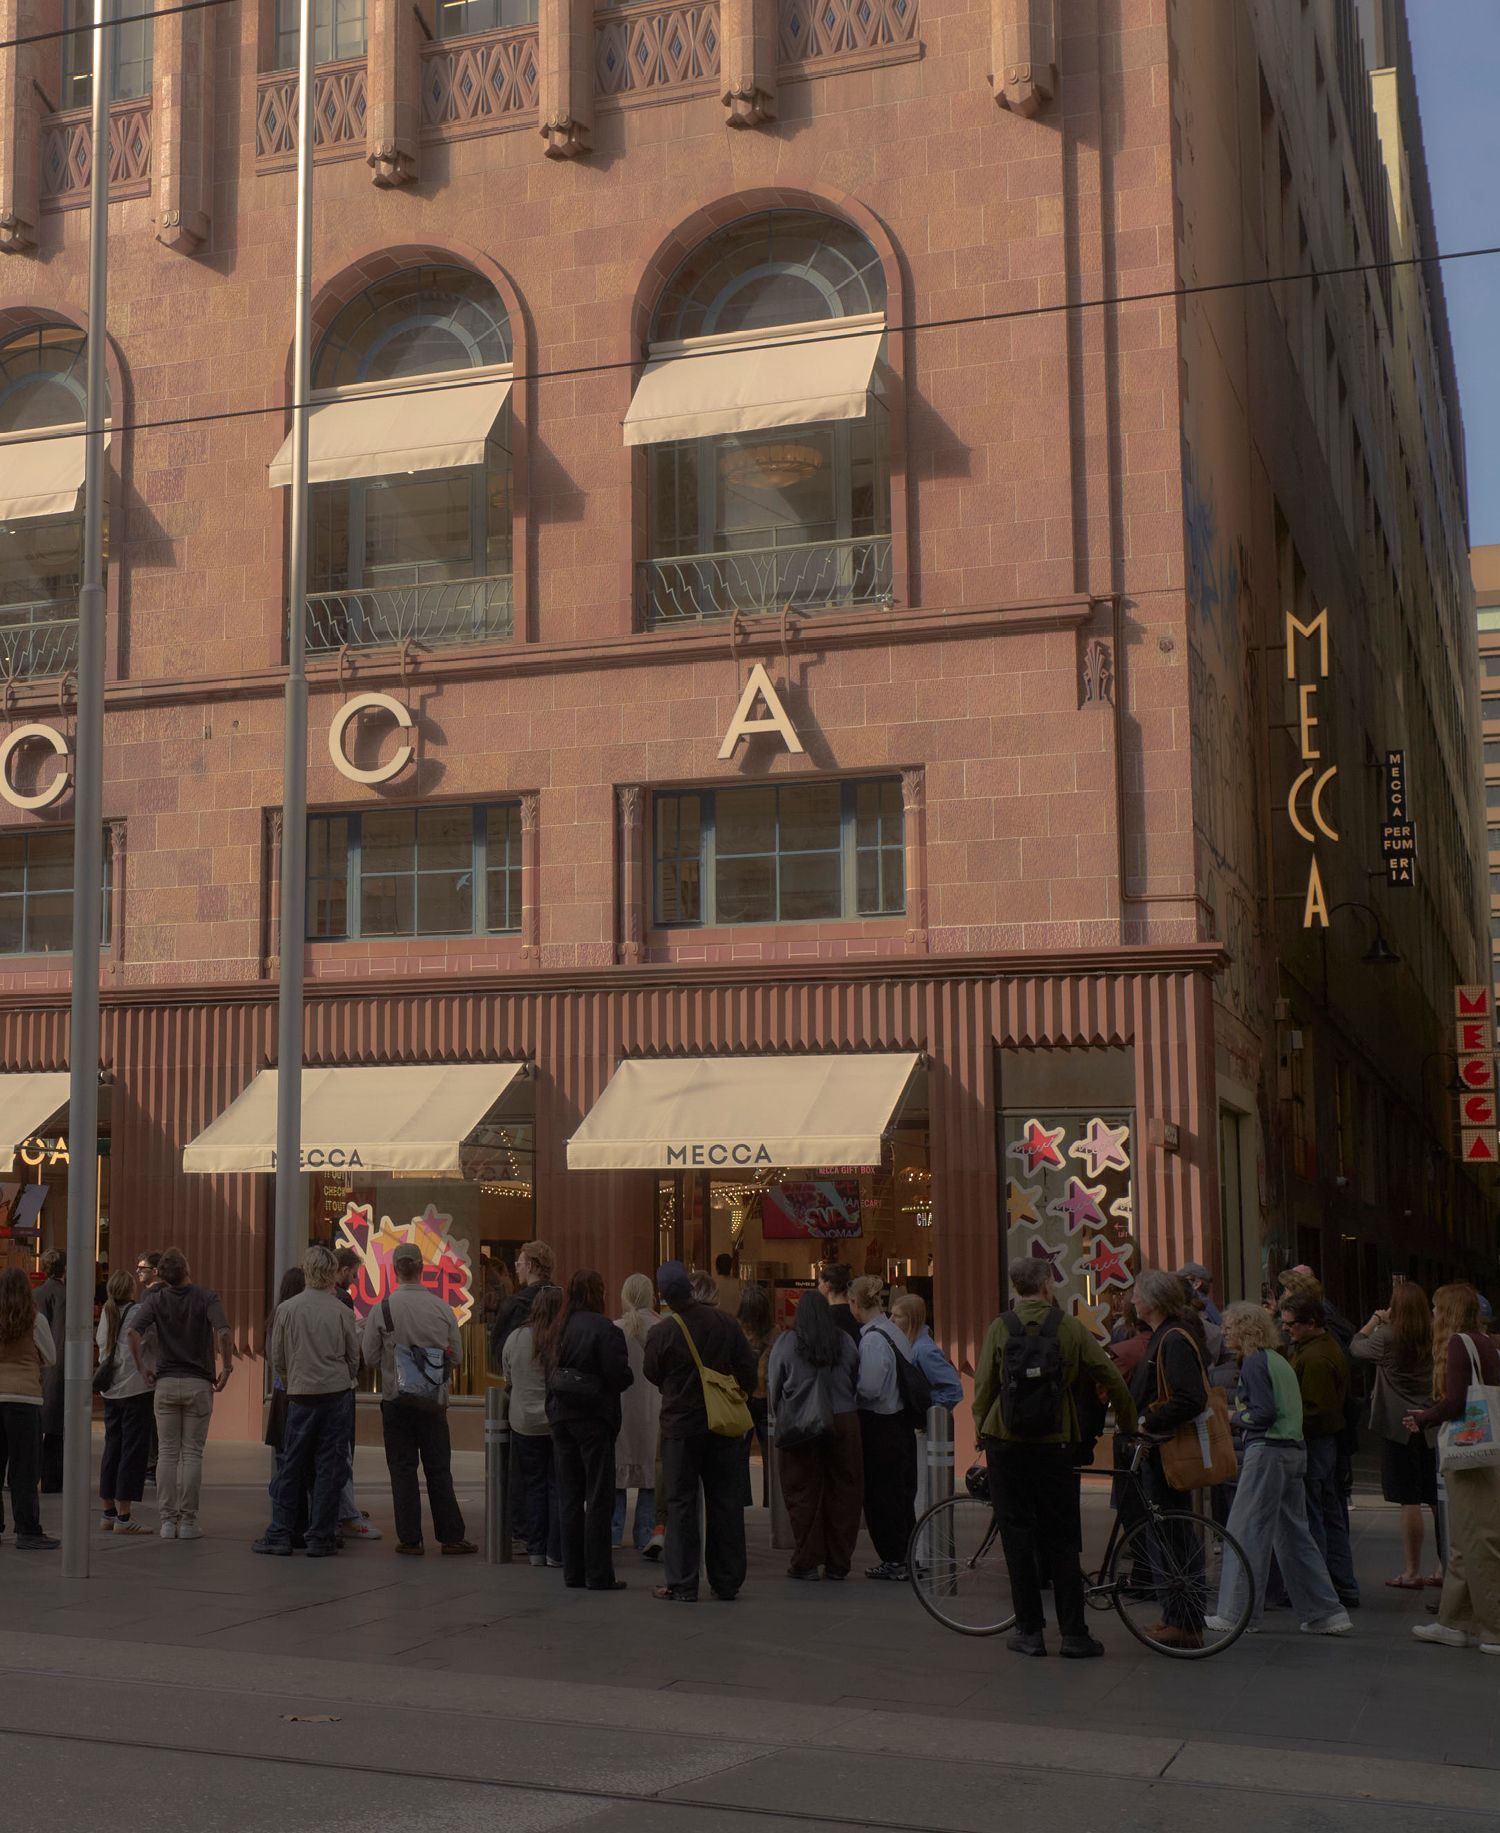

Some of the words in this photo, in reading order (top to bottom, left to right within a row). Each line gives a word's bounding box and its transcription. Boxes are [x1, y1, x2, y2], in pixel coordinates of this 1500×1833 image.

[1286, 607, 1339, 928] MECCA
[1389, 753, 1402, 817] MECCA
[1384, 826, 1411, 837] PER
[1383, 839, 1413, 850] FUM
[1389, 857, 1409, 869] ER
[667, 1143, 772, 1165] MECCA
